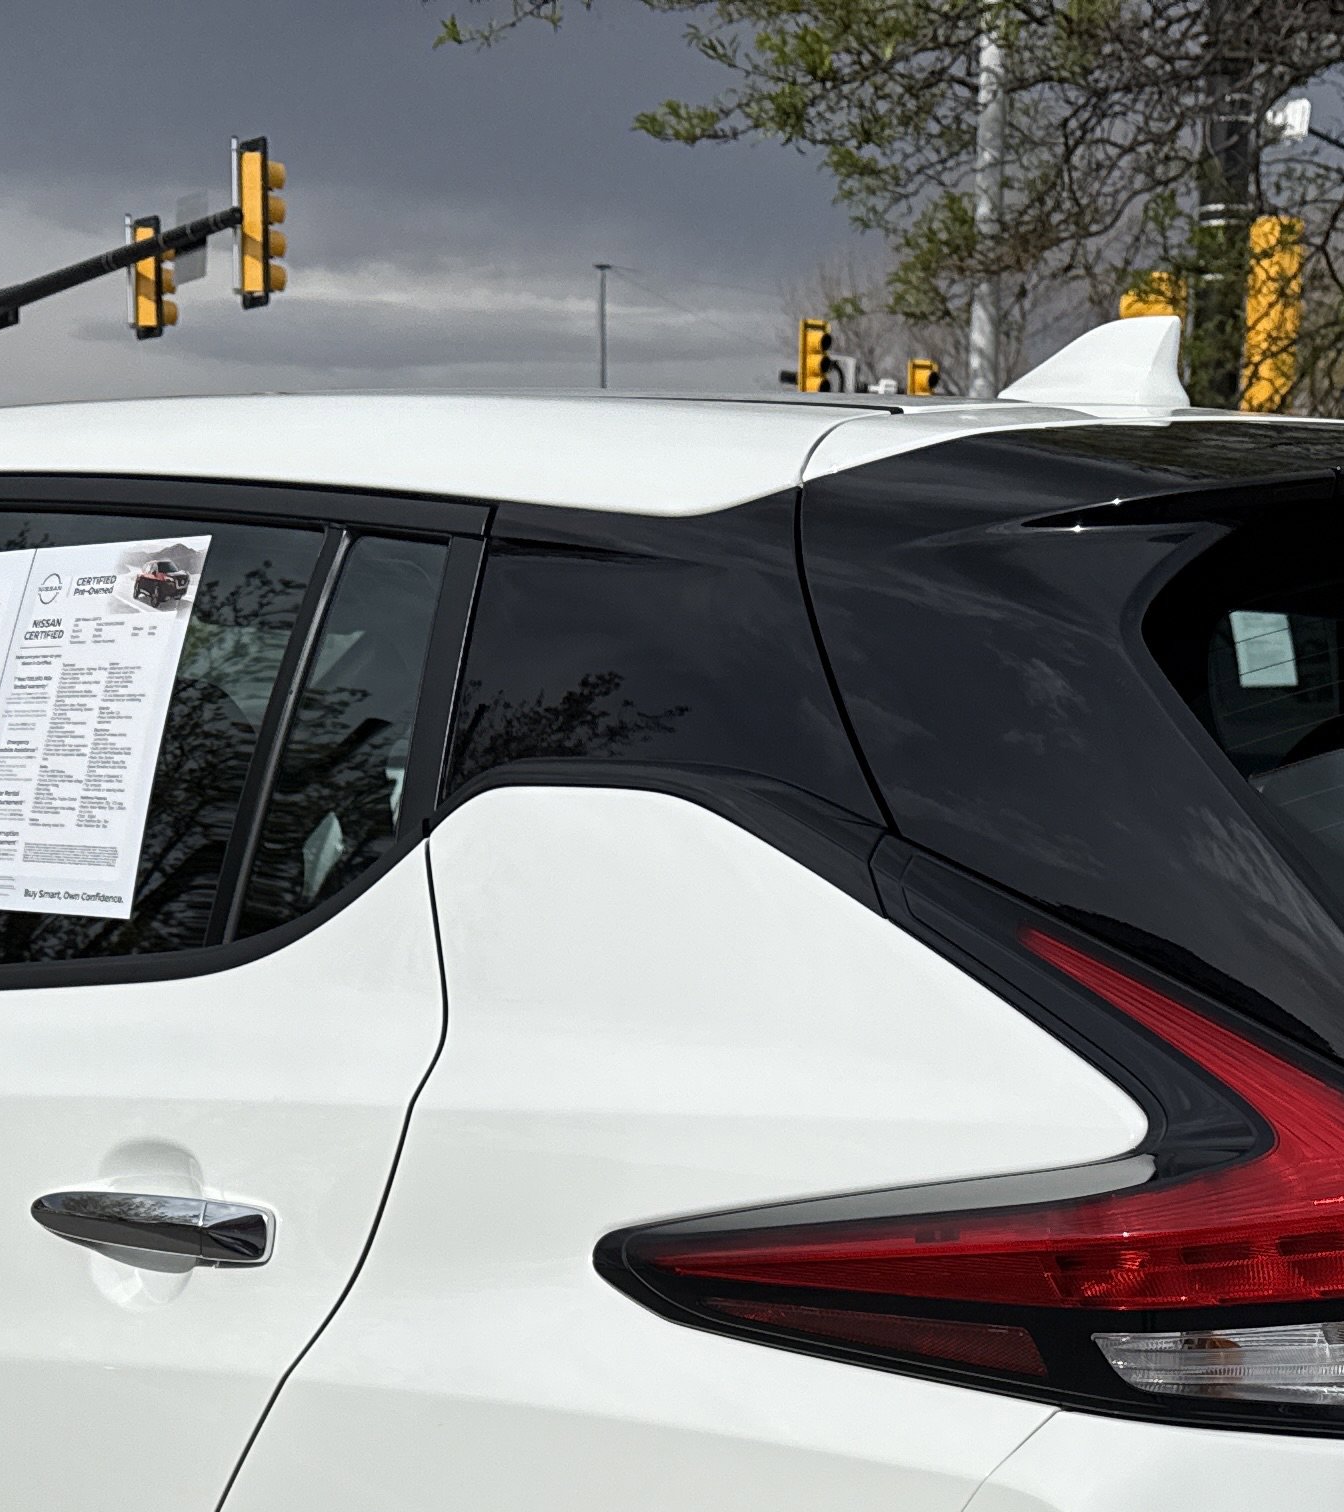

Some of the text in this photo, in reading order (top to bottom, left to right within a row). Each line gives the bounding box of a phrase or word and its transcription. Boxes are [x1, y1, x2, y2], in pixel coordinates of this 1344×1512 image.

[76, 575, 117, 586] CERTIFIED
[32, 618, 63, 628] NISSAN
[24, 630, 64, 641] CERTIFIED
[24, 888, 37, 900] Buy
[39, 889, 62, 900] Smart,
[63, 891, 80, 900] Own
